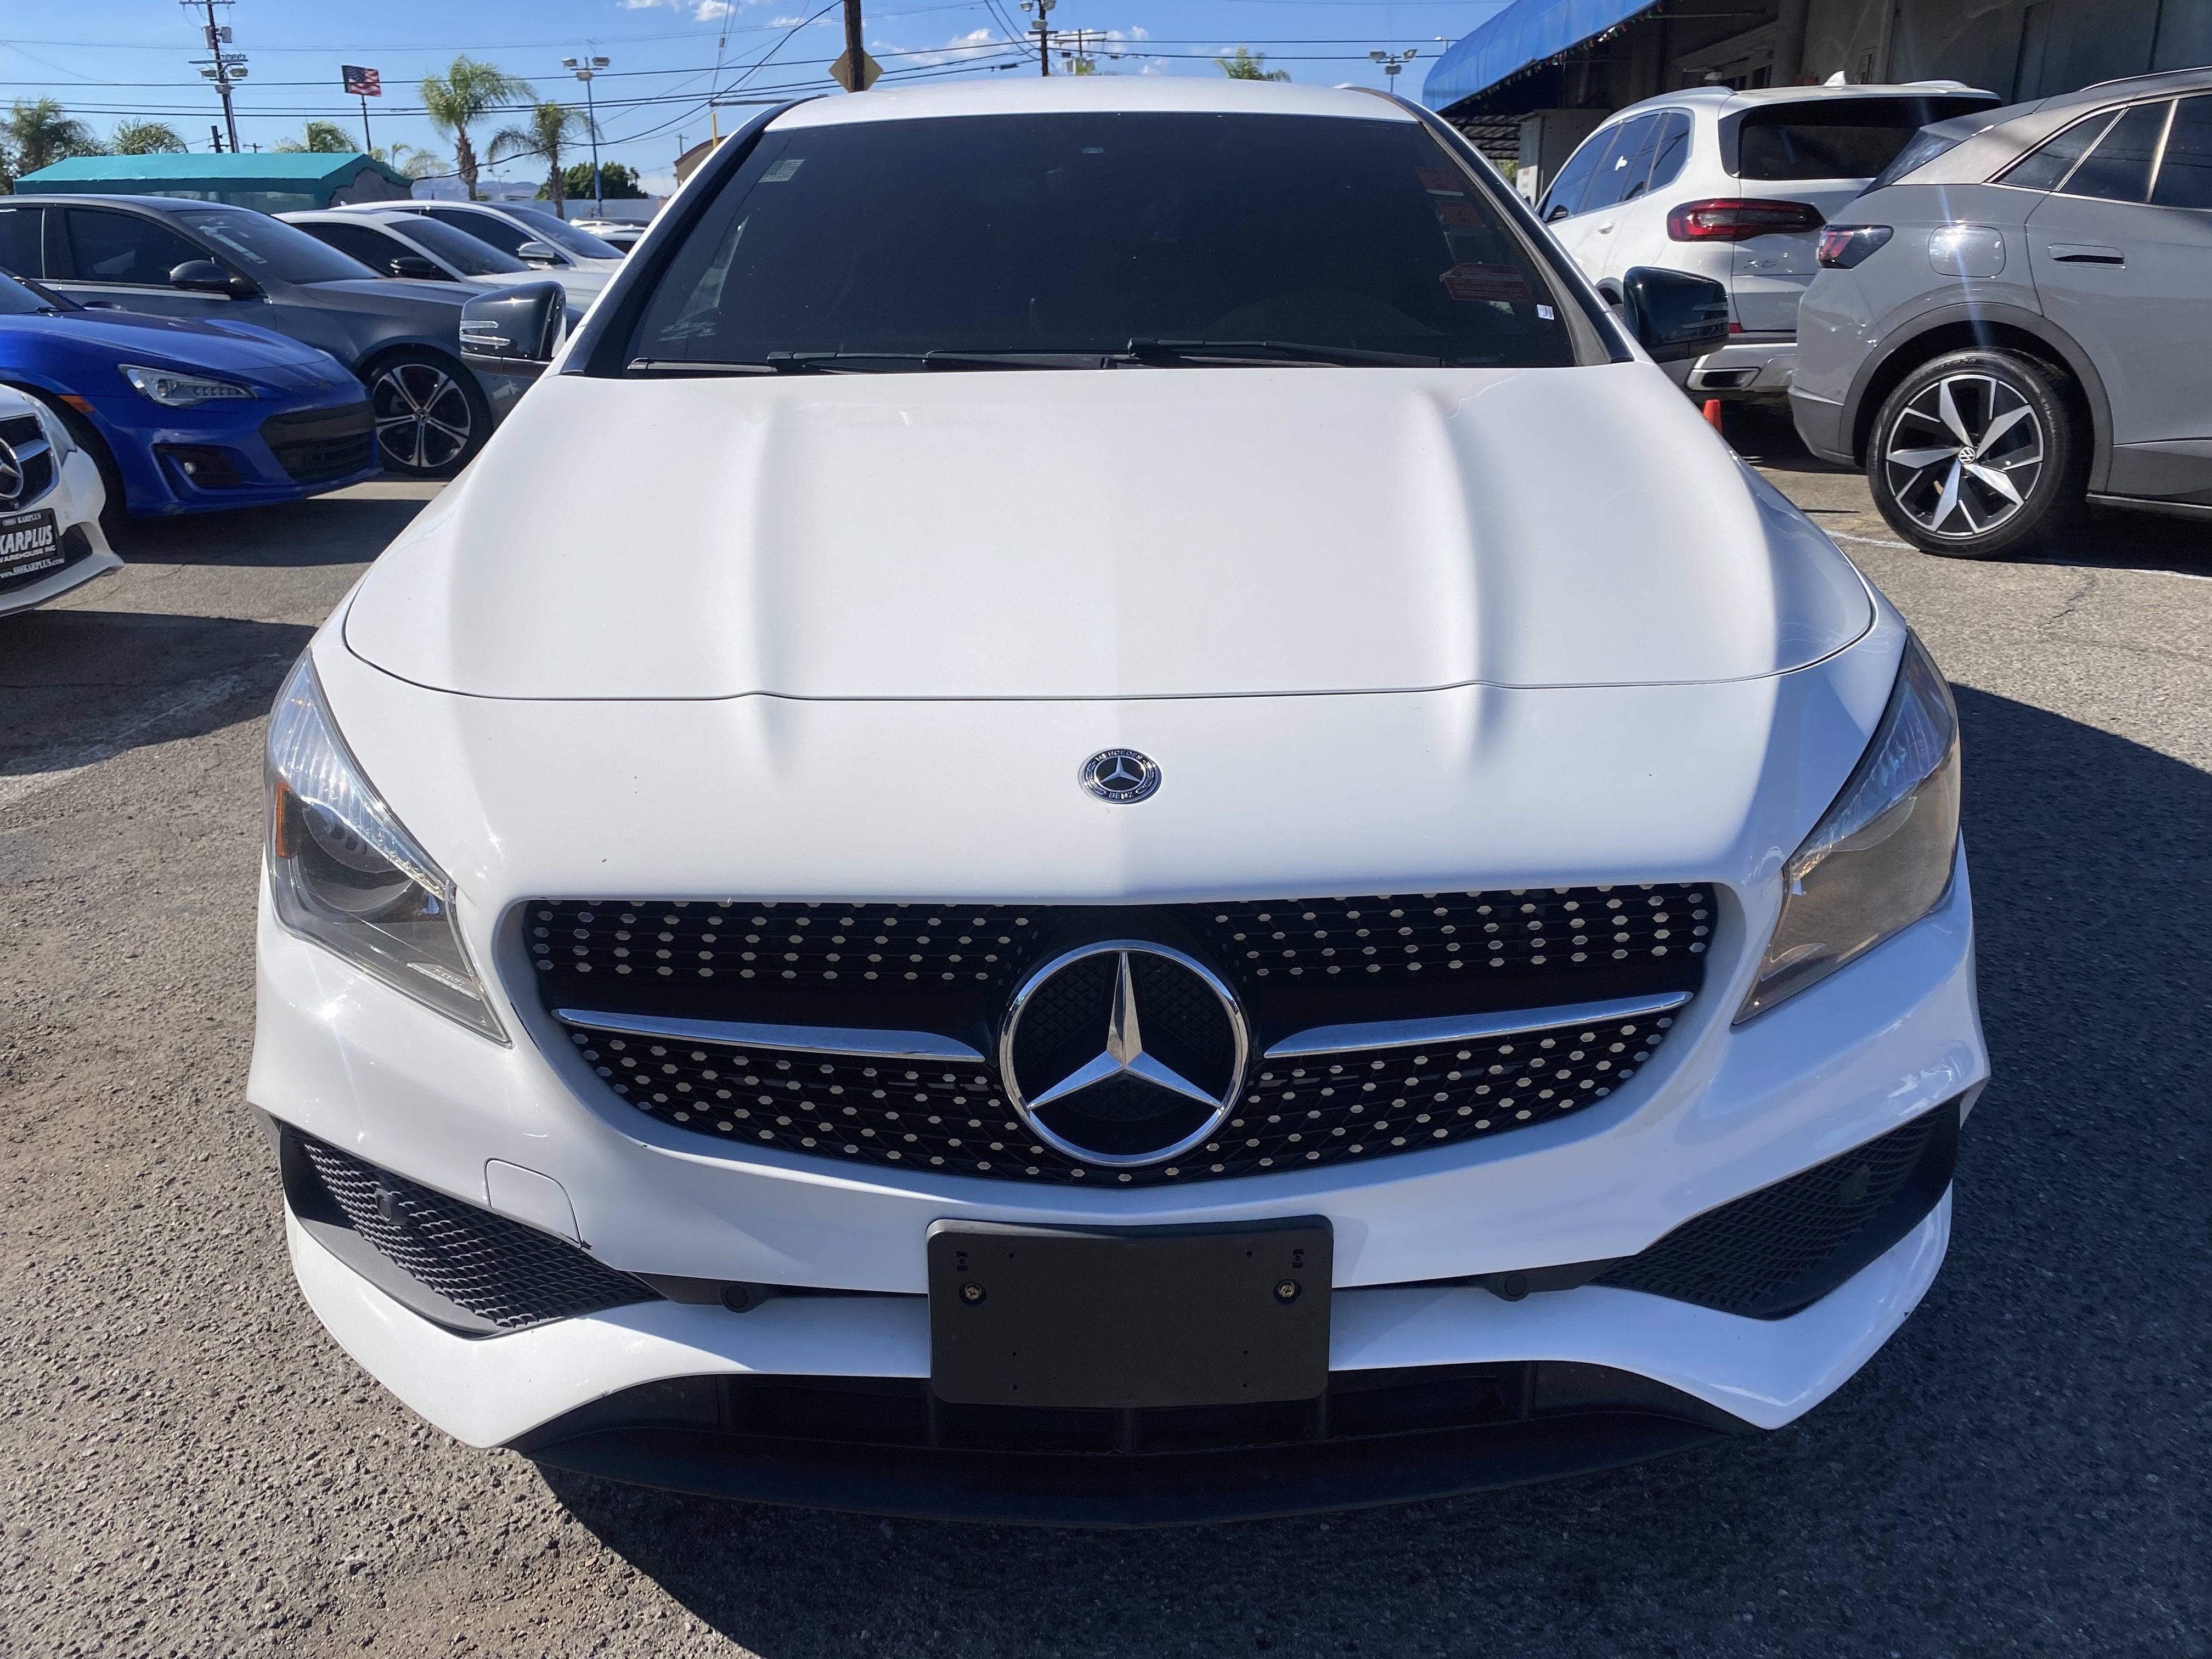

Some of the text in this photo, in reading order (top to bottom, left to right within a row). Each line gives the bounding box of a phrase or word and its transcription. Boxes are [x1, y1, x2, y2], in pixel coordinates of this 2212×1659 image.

[18, 512, 42, 524] KARPLUS
[1095, 750, 1143, 762] MERCEDES
[1108, 791, 1135, 799] BENZ
